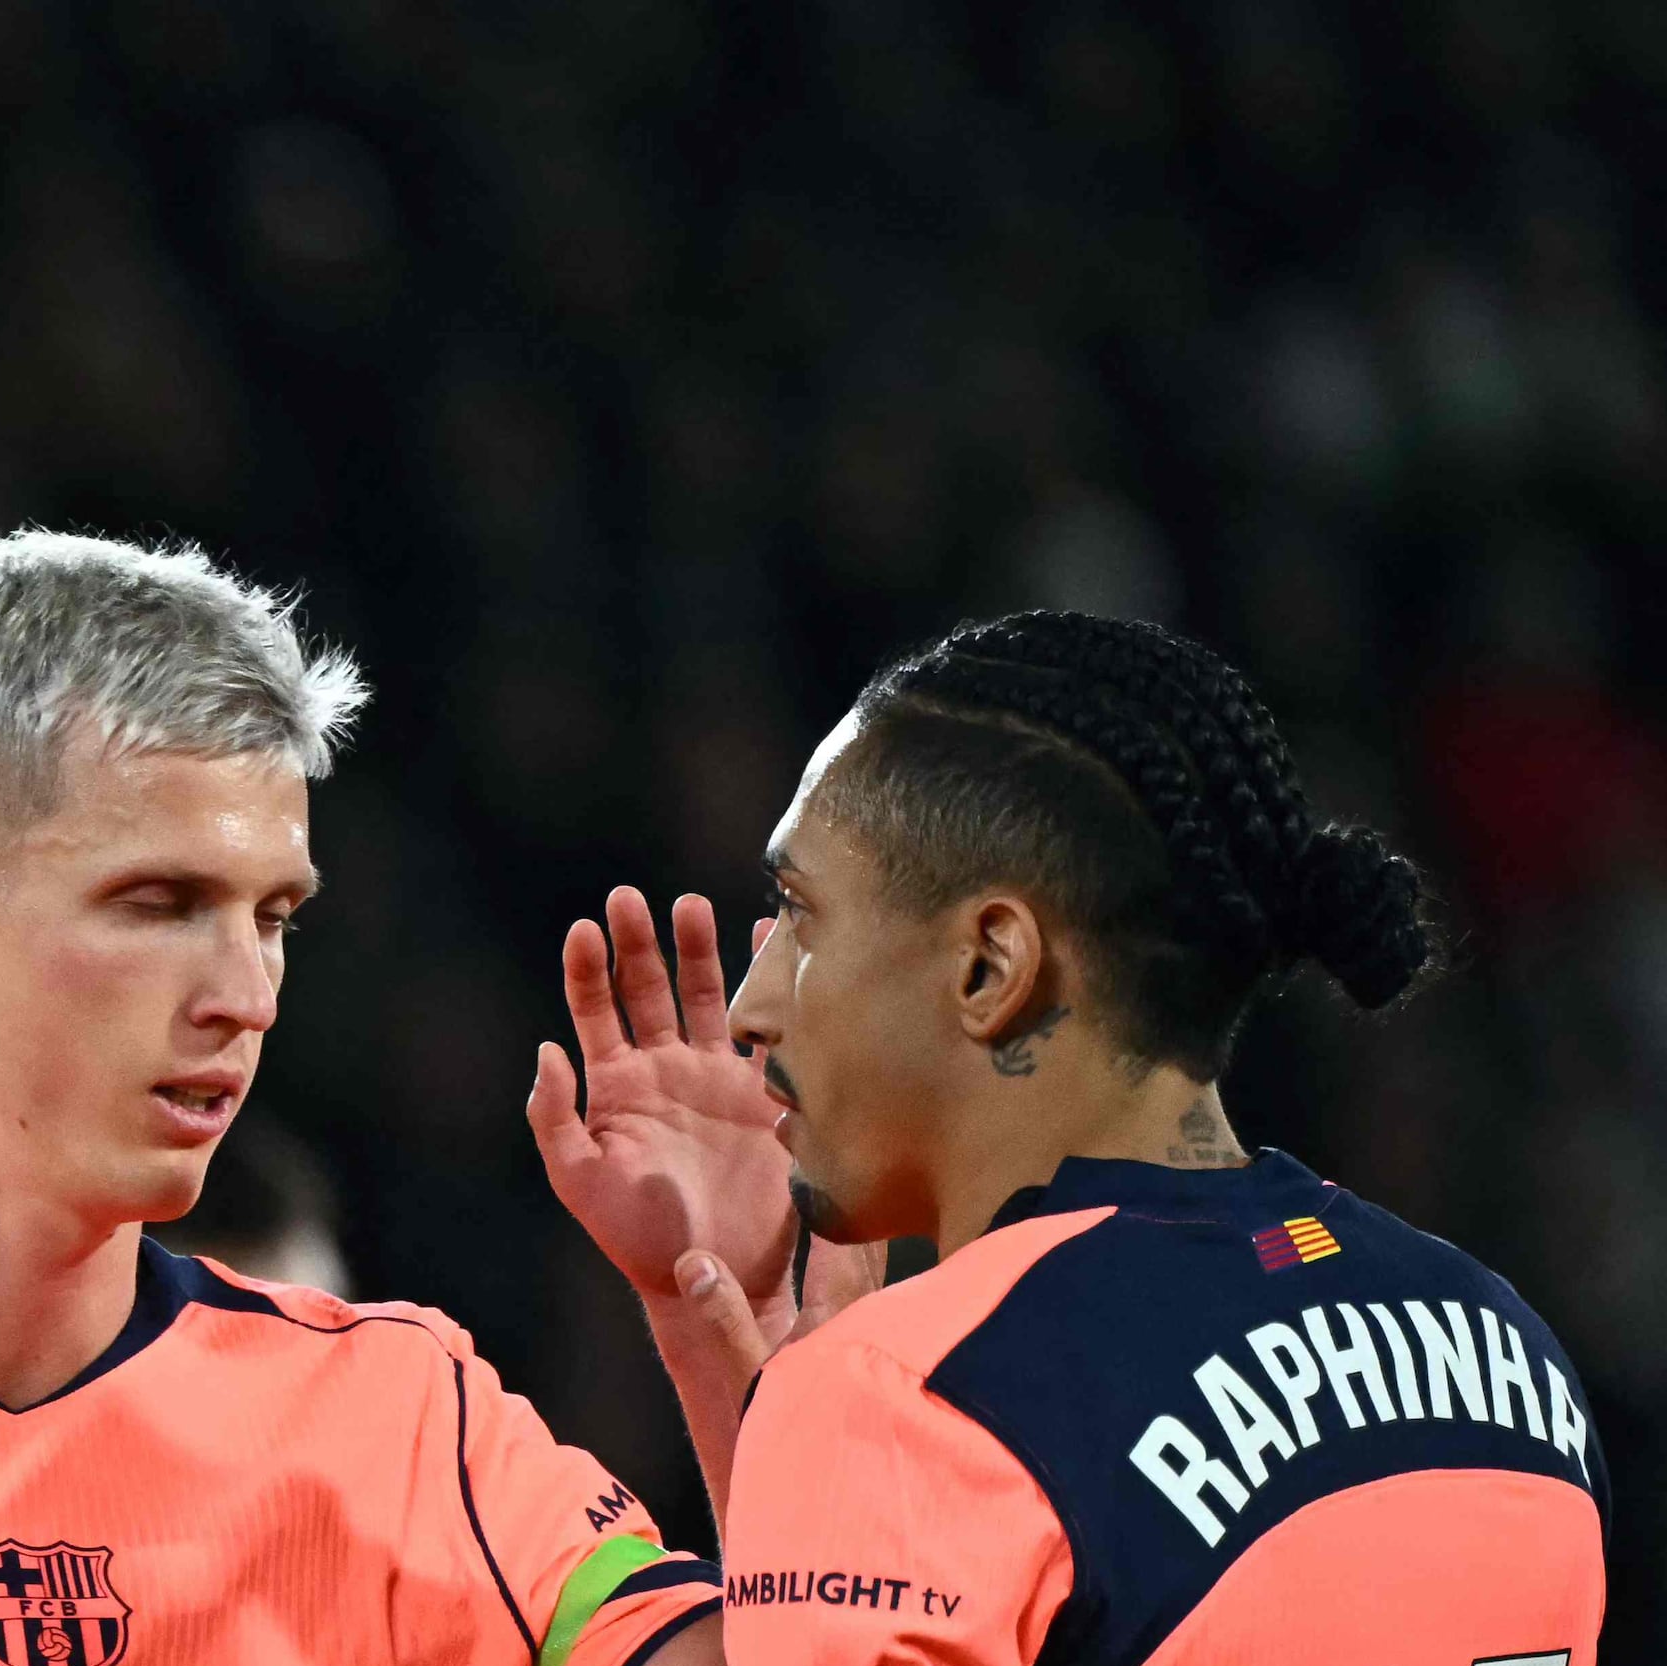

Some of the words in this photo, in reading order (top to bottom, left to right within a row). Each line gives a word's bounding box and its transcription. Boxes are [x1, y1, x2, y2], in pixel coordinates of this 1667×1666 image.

[1128, 1300, 1592, 1548] RAPHINHA
[725, 1571, 911, 1612] AMBILIGHT
[922, 1586, 961, 1617] tv
